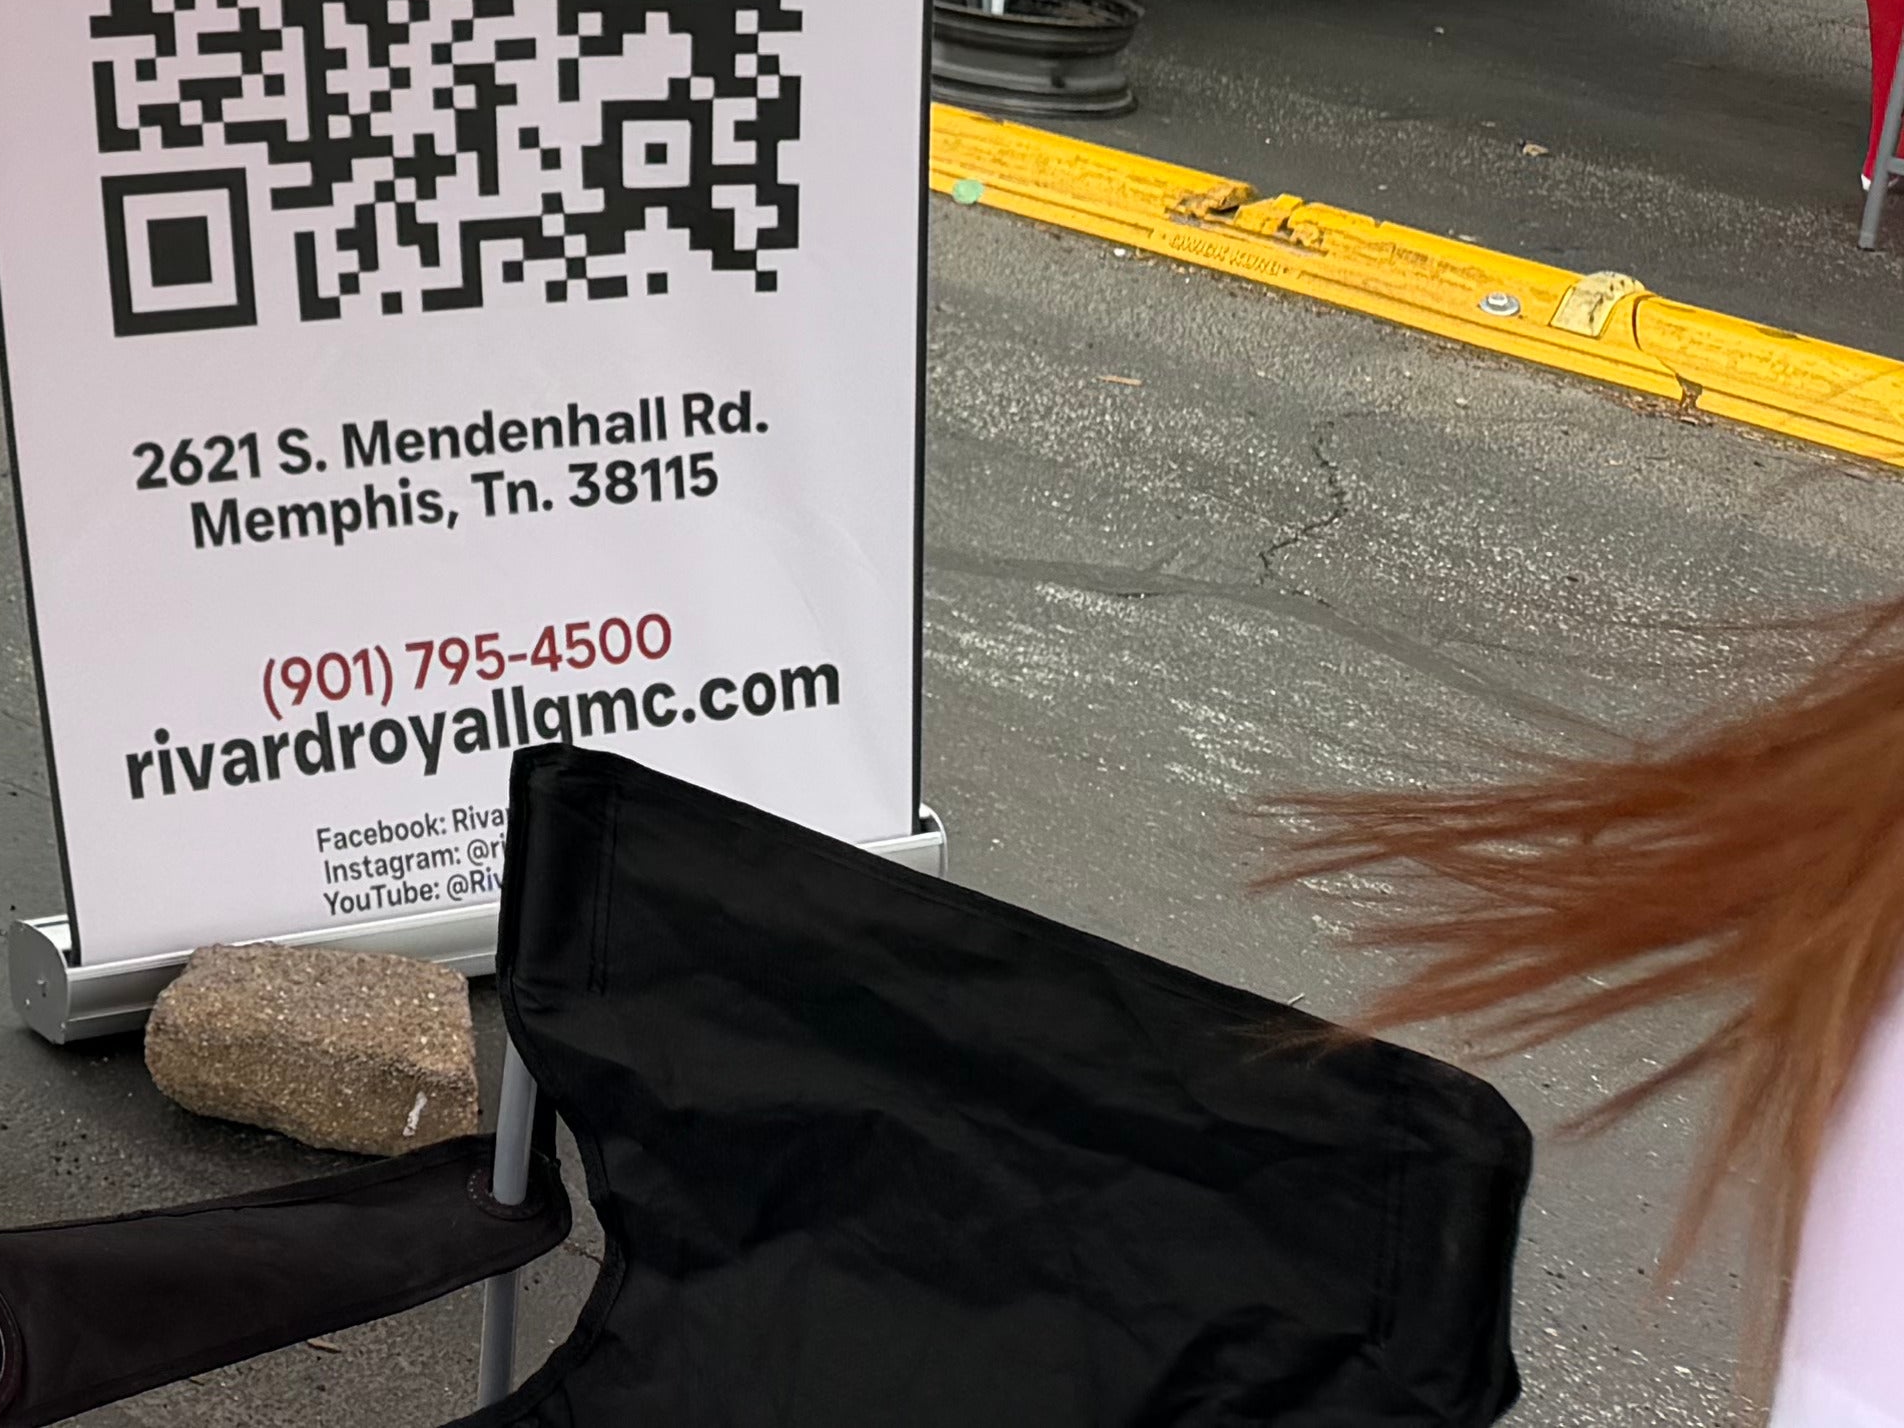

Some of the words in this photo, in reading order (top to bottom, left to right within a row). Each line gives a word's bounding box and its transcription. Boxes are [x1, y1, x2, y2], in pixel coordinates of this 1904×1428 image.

[133, 433, 262, 492] 2621
[277, 425, 326, 474] S.
[343, 394, 668, 468] Mendenhall
[682, 390, 770, 437] Rd.
[191, 477, 459, 549] Memphis,
[471, 466, 554, 519] Tn.
[567, 451, 719, 509] 38115
[262, 648, 393, 721] (901)
[406, 613, 672, 691] 795-4500
[125, 659, 841, 799] rivardroyallgmc.com
[316, 812, 447, 853] Facebook:
[324, 846, 461, 885] Instagram:
[323, 881, 441, 916] YouTube:
